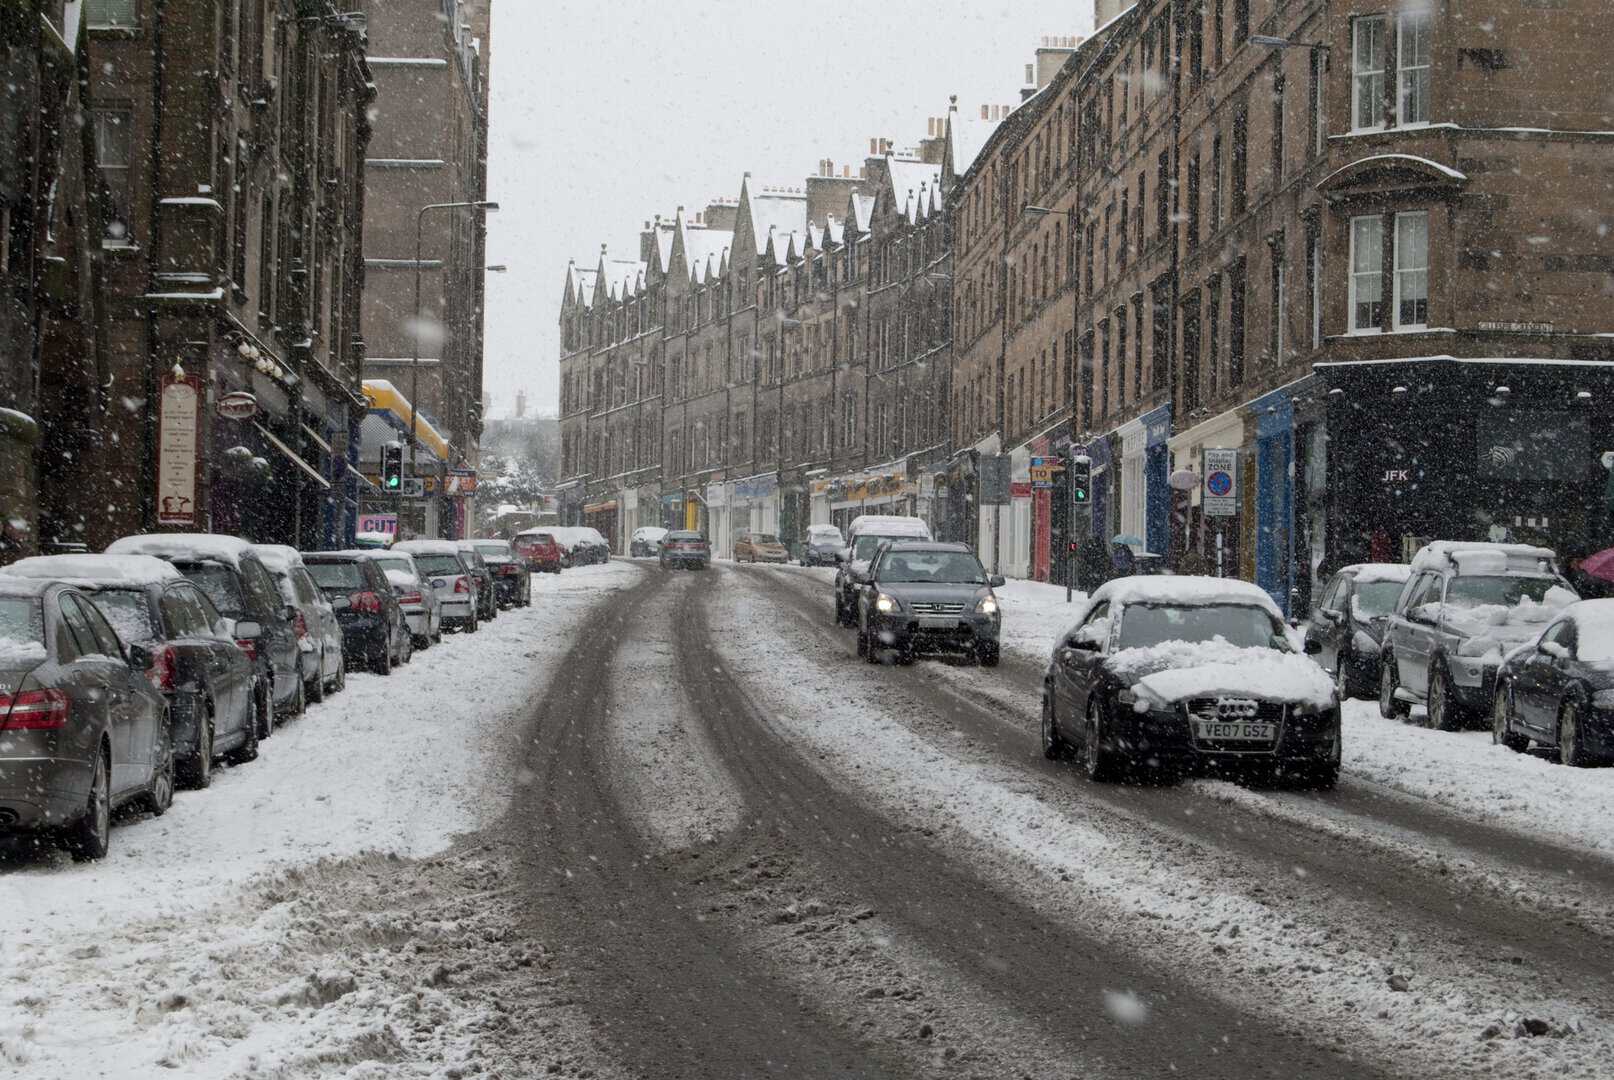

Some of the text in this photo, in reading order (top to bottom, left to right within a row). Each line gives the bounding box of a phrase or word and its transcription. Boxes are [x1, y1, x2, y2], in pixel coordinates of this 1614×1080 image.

[1207, 463, 1232, 471] ZONE
[1382, 470, 1408, 481] JFK
[364, 519, 396, 533] CUT
[1243, 725, 1269, 738] GSZ
